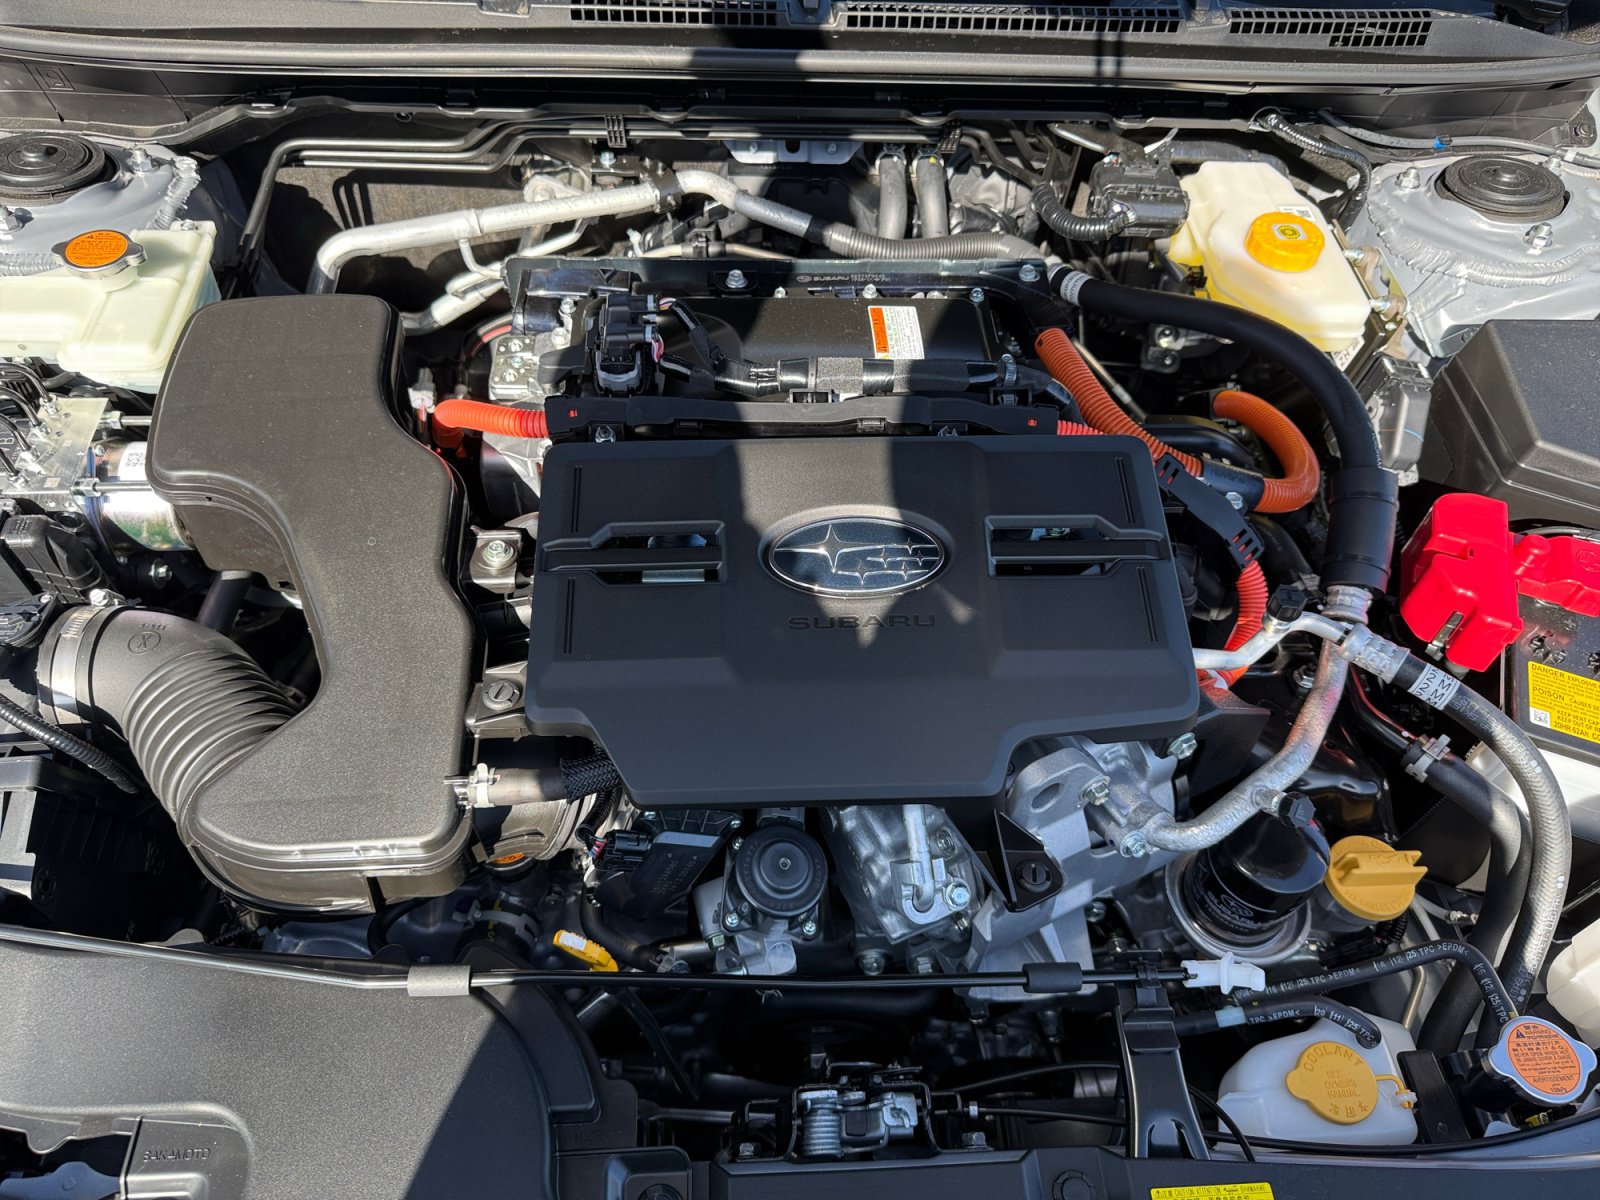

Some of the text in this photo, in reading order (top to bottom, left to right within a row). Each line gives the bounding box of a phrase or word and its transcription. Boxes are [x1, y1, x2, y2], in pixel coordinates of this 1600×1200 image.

[788, 614, 935, 630] SUBARU
[1531, 663, 1565, 679] DANGER
[1532, 685, 1565, 702] POISON
[1420, 945, 1435, 956] TPC
[1311, 974, 1327, 984] TPC
[1303, 1045, 1363, 1072] COOLANT
[143, 1148, 211, 1162] SAKAMOTO
